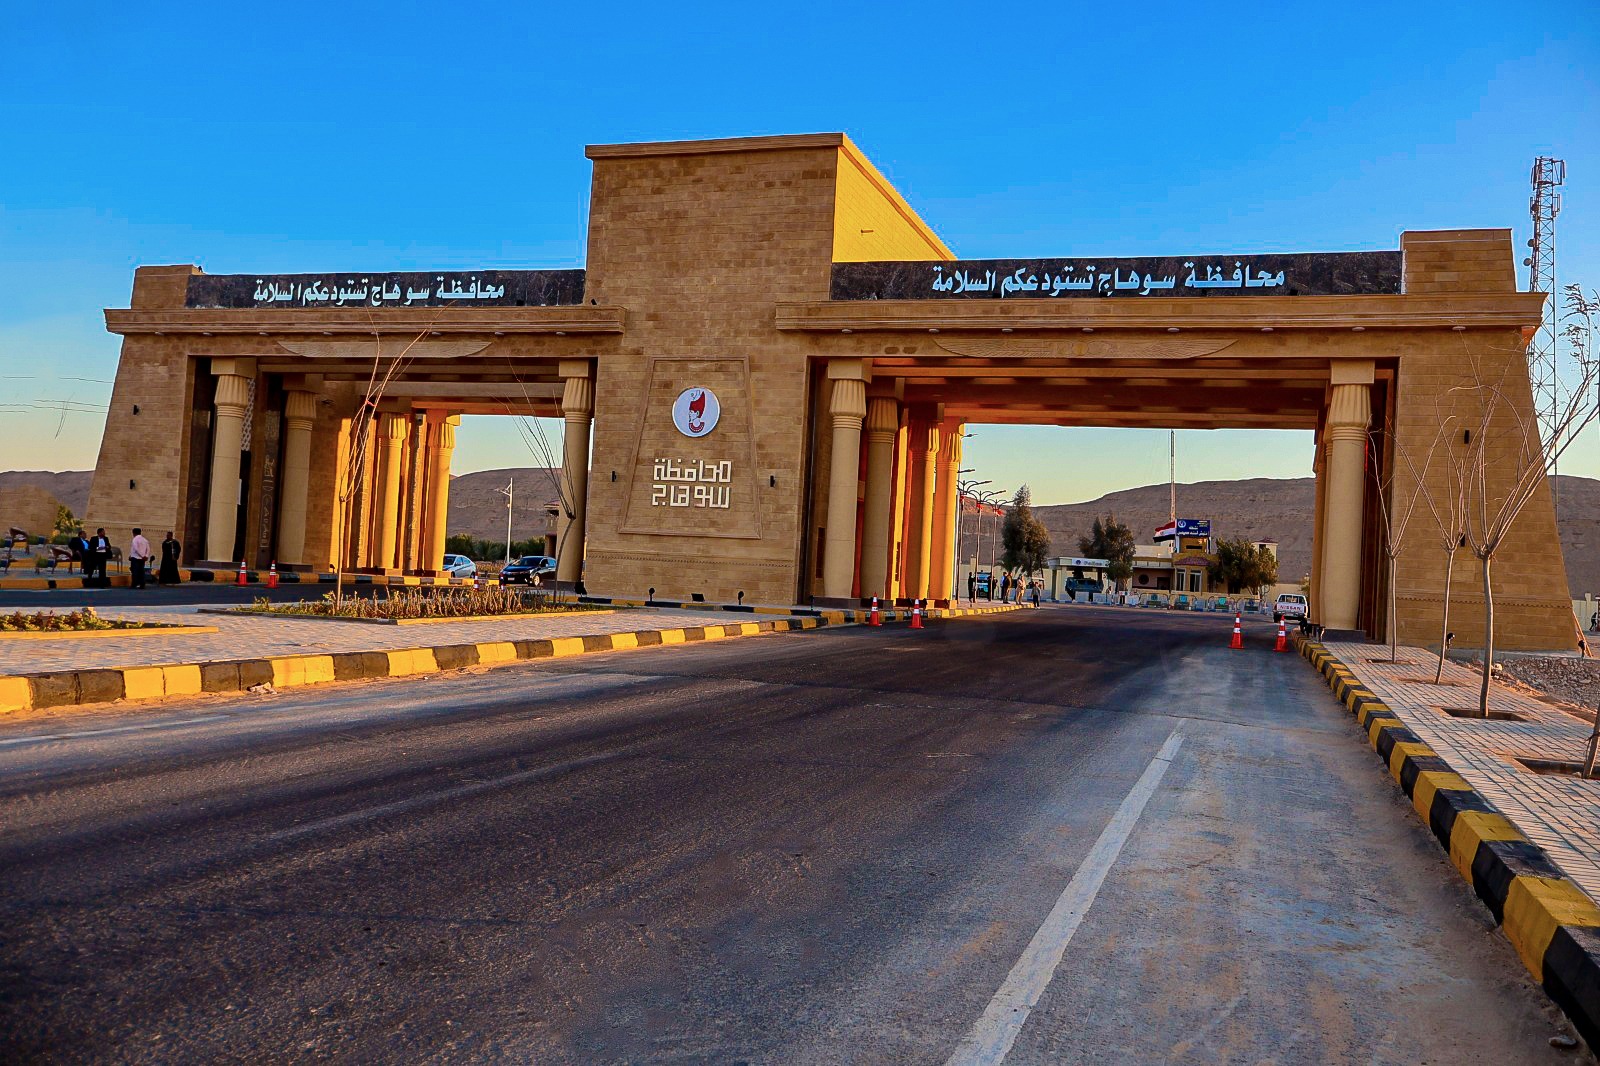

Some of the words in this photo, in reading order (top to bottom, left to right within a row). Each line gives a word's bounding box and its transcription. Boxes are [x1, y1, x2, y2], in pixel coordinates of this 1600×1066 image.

[435, 275, 505, 300] محافظة
[931, 266, 997, 294] السلامة
[1000, 265, 1097, 299] تستودعكم
[1097, 267, 1176, 297] سوهاج
[1184, 261, 1286, 289] محافظة
[253, 278, 302, 303] السلامة
[302, 277, 369, 307] تستودعكم
[371, 281, 430, 307] سوهاج
[653, 458, 732, 483] محافظة
[651, 484, 730, 509] سوهاج
